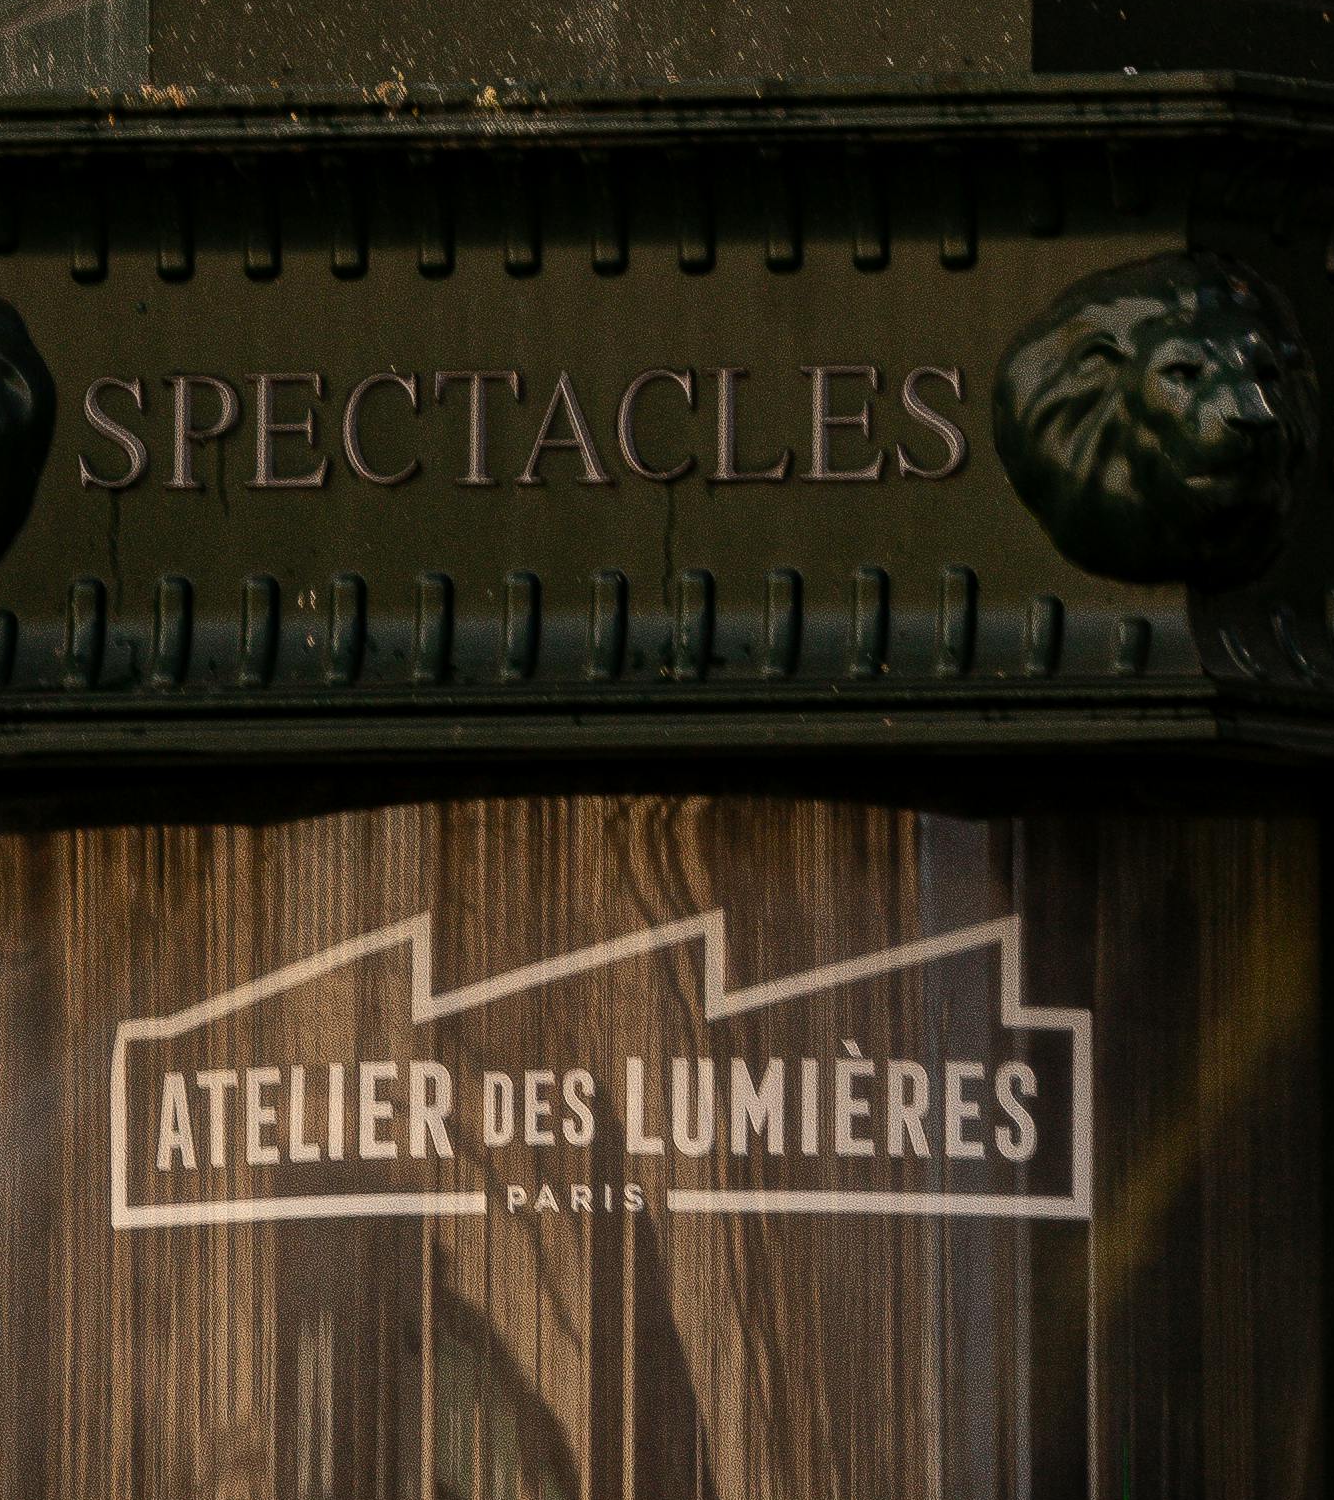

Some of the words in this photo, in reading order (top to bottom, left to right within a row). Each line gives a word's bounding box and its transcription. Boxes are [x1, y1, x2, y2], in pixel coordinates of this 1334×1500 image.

[78, 365, 969, 492] SPECTACLES
[156, 1058, 456, 1171] ATELIER
[482, 1068, 595, 1150] DES
[625, 1041, 1039, 1162] LUMIÈRES
[507, 1184, 645, 1213] PARIS
